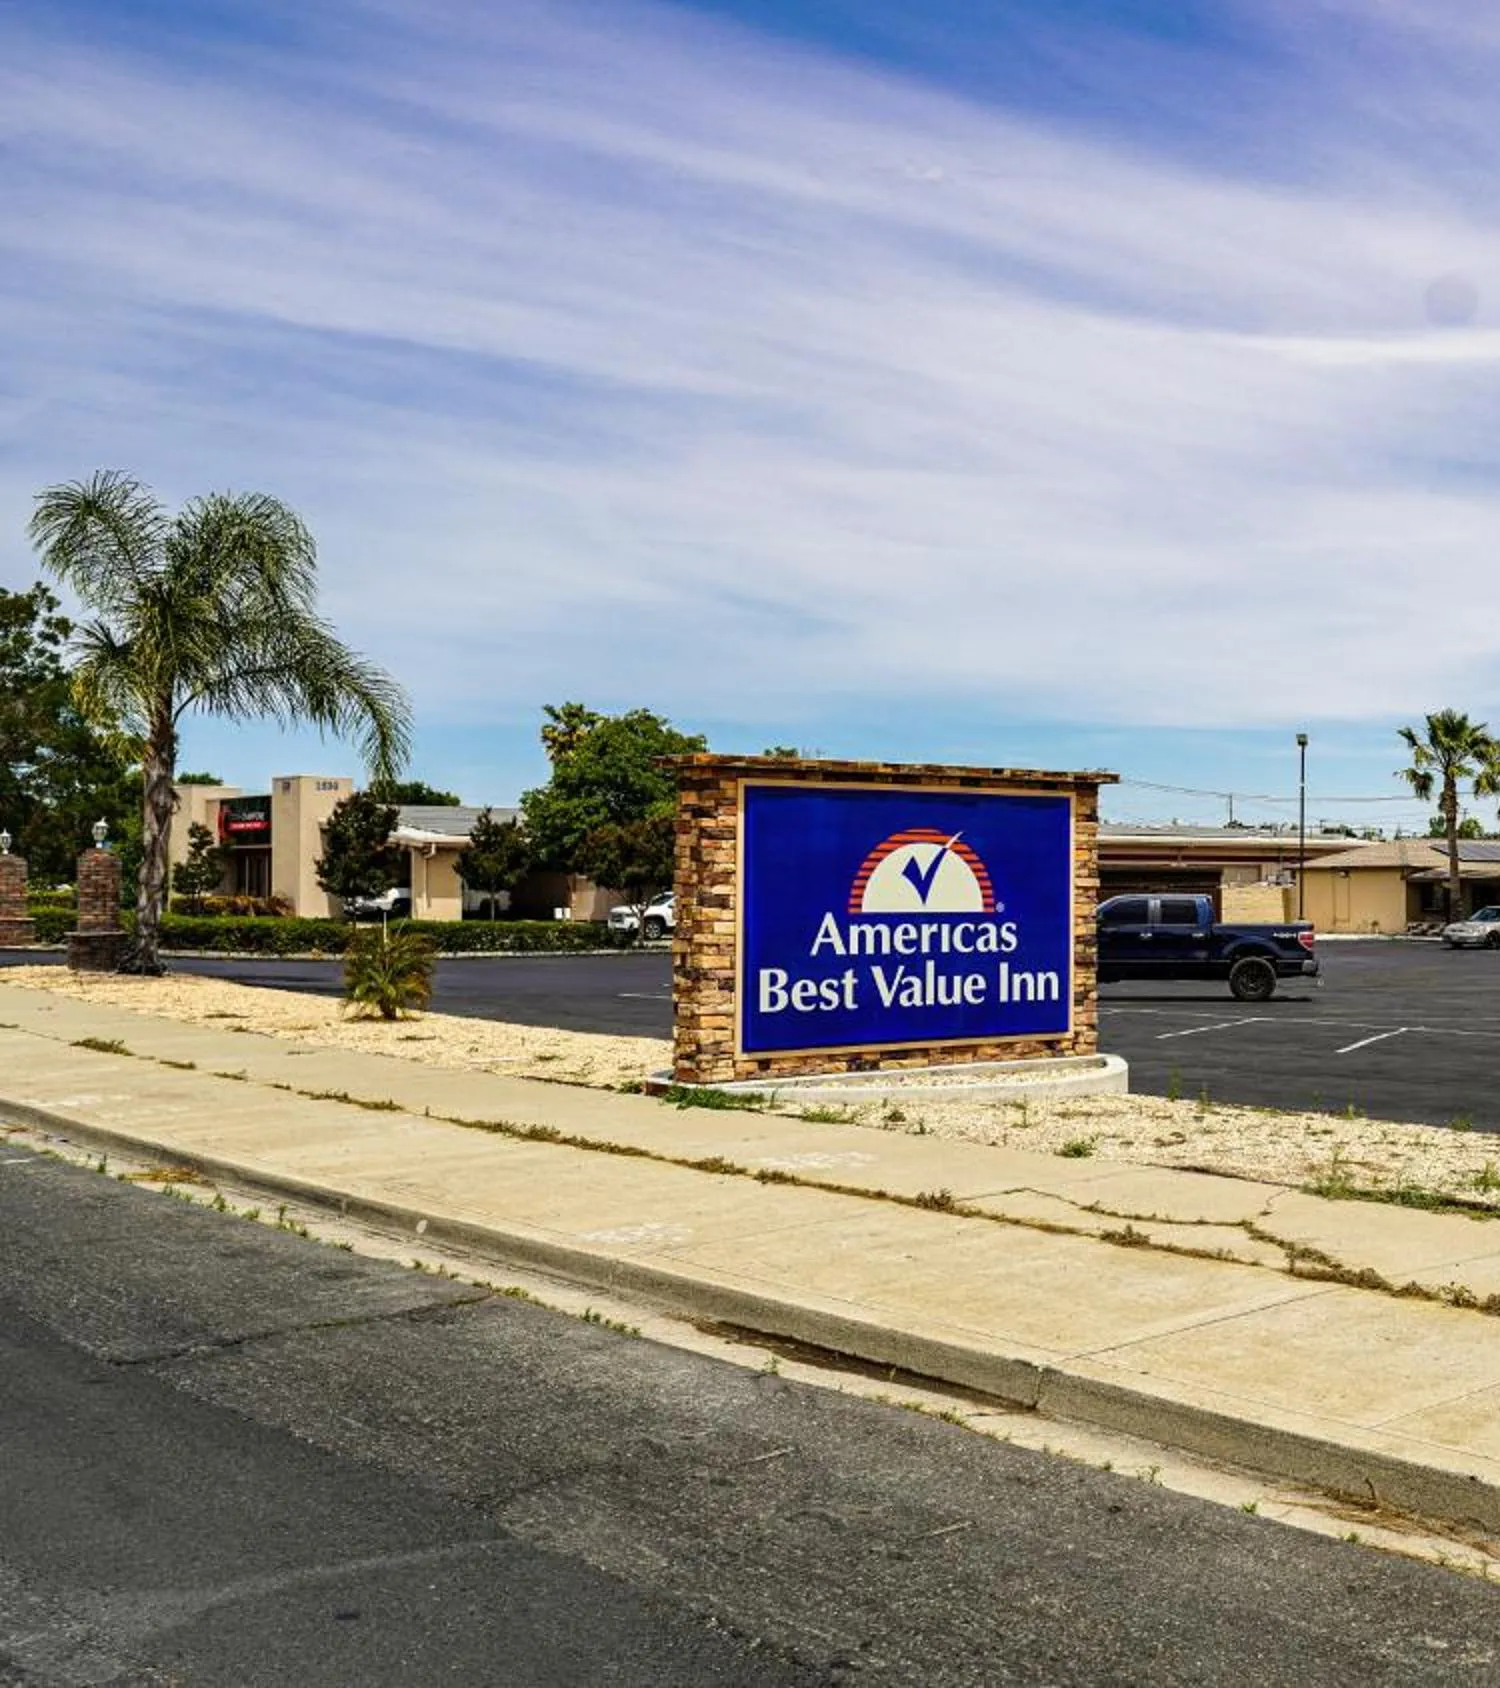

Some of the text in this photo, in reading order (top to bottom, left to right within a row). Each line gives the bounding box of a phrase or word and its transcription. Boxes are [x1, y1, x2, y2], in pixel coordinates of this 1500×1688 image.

[810, 911, 1018, 956] Americas
[759, 959, 1059, 1013] Best Value Inn
